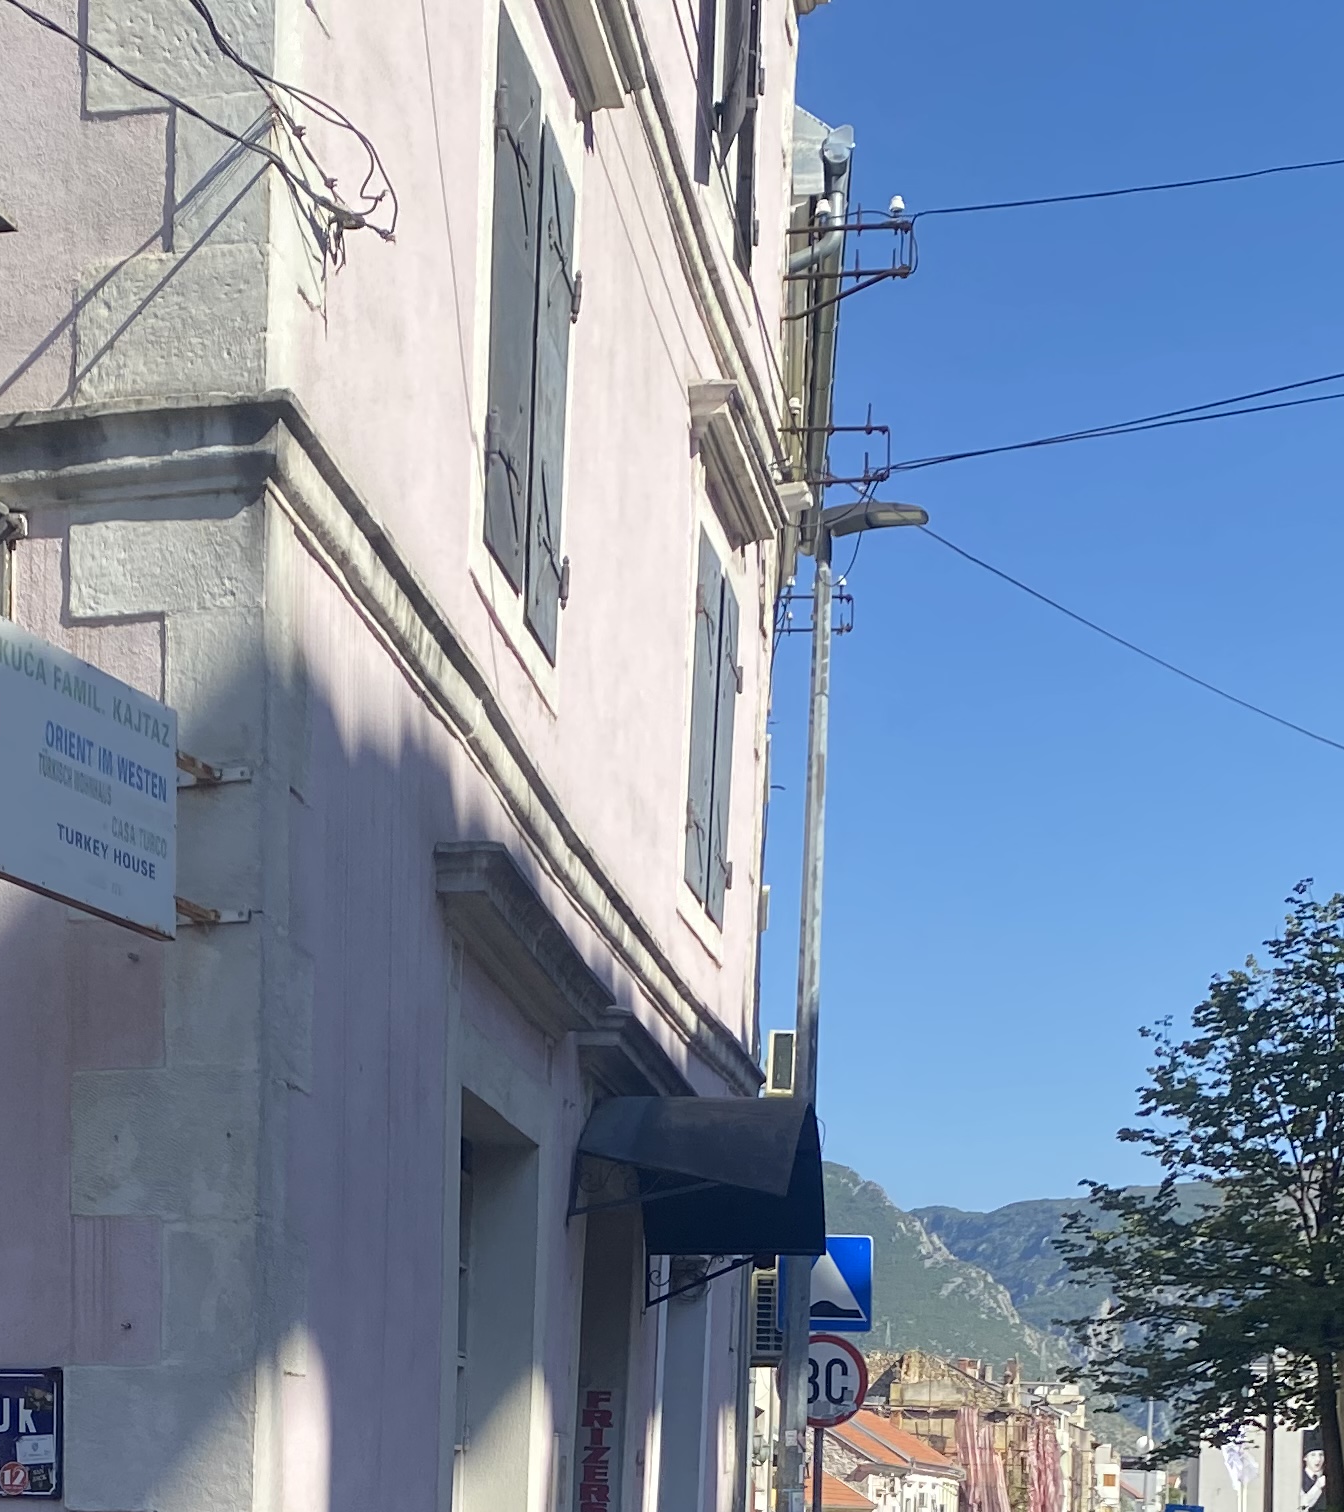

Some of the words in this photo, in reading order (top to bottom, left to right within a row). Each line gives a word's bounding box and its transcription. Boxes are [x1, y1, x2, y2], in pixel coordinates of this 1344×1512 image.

[112, 696, 170, 748] KAJTAZ
[45, 720, 94, 767] ORIENT
[98, 745, 113, 777] IM
[117, 753, 167, 803] WESTEN
[56, 822, 109, 860] TURKEY
[113, 848, 156, 881] HOUSE
[111, 816, 136, 846] CASA
[3, 1468, 25, 1486] 12
